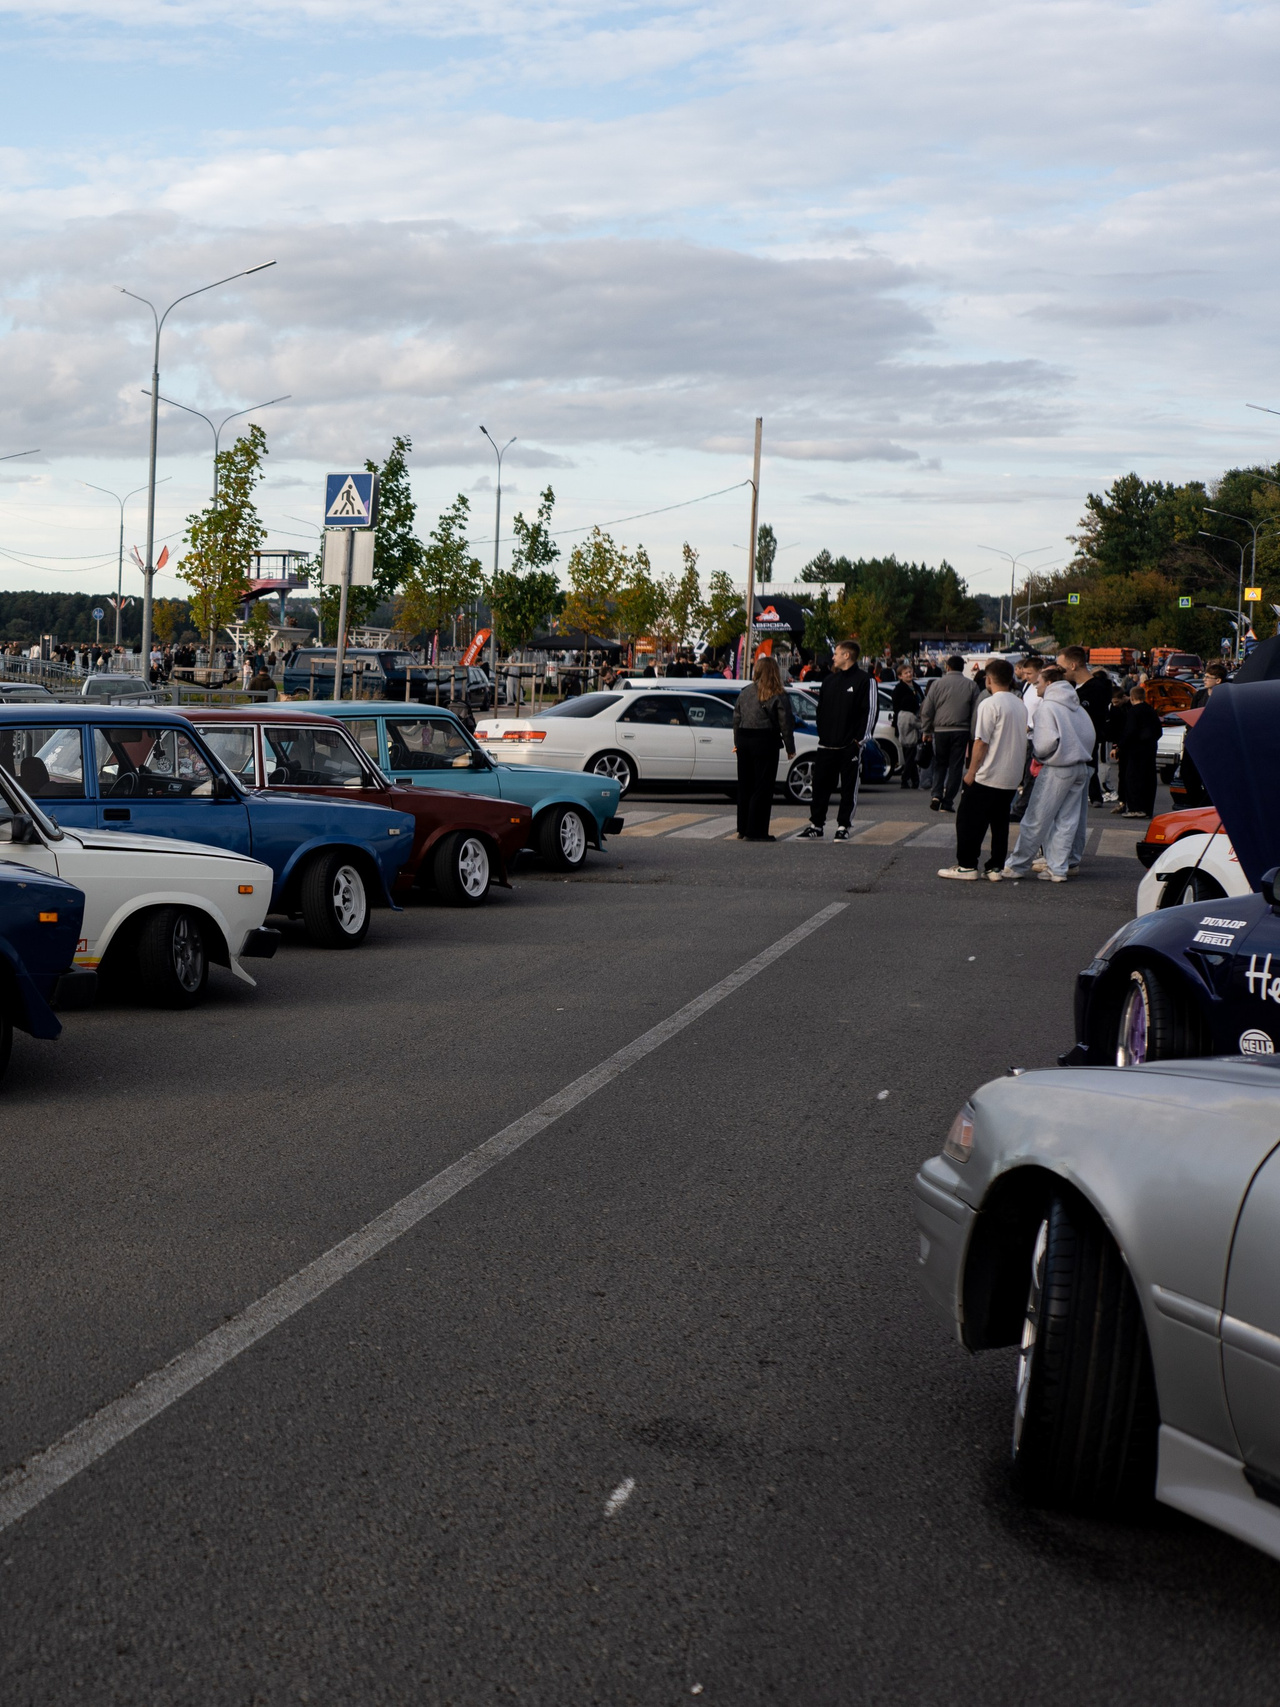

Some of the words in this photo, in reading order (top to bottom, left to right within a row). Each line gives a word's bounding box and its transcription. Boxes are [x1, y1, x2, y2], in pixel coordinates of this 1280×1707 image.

[1200, 916, 1247, 929] DUNLOP
[1193, 930, 1235, 947] PIRELLI
[1242, 1040, 1274, 1055] HELLA
